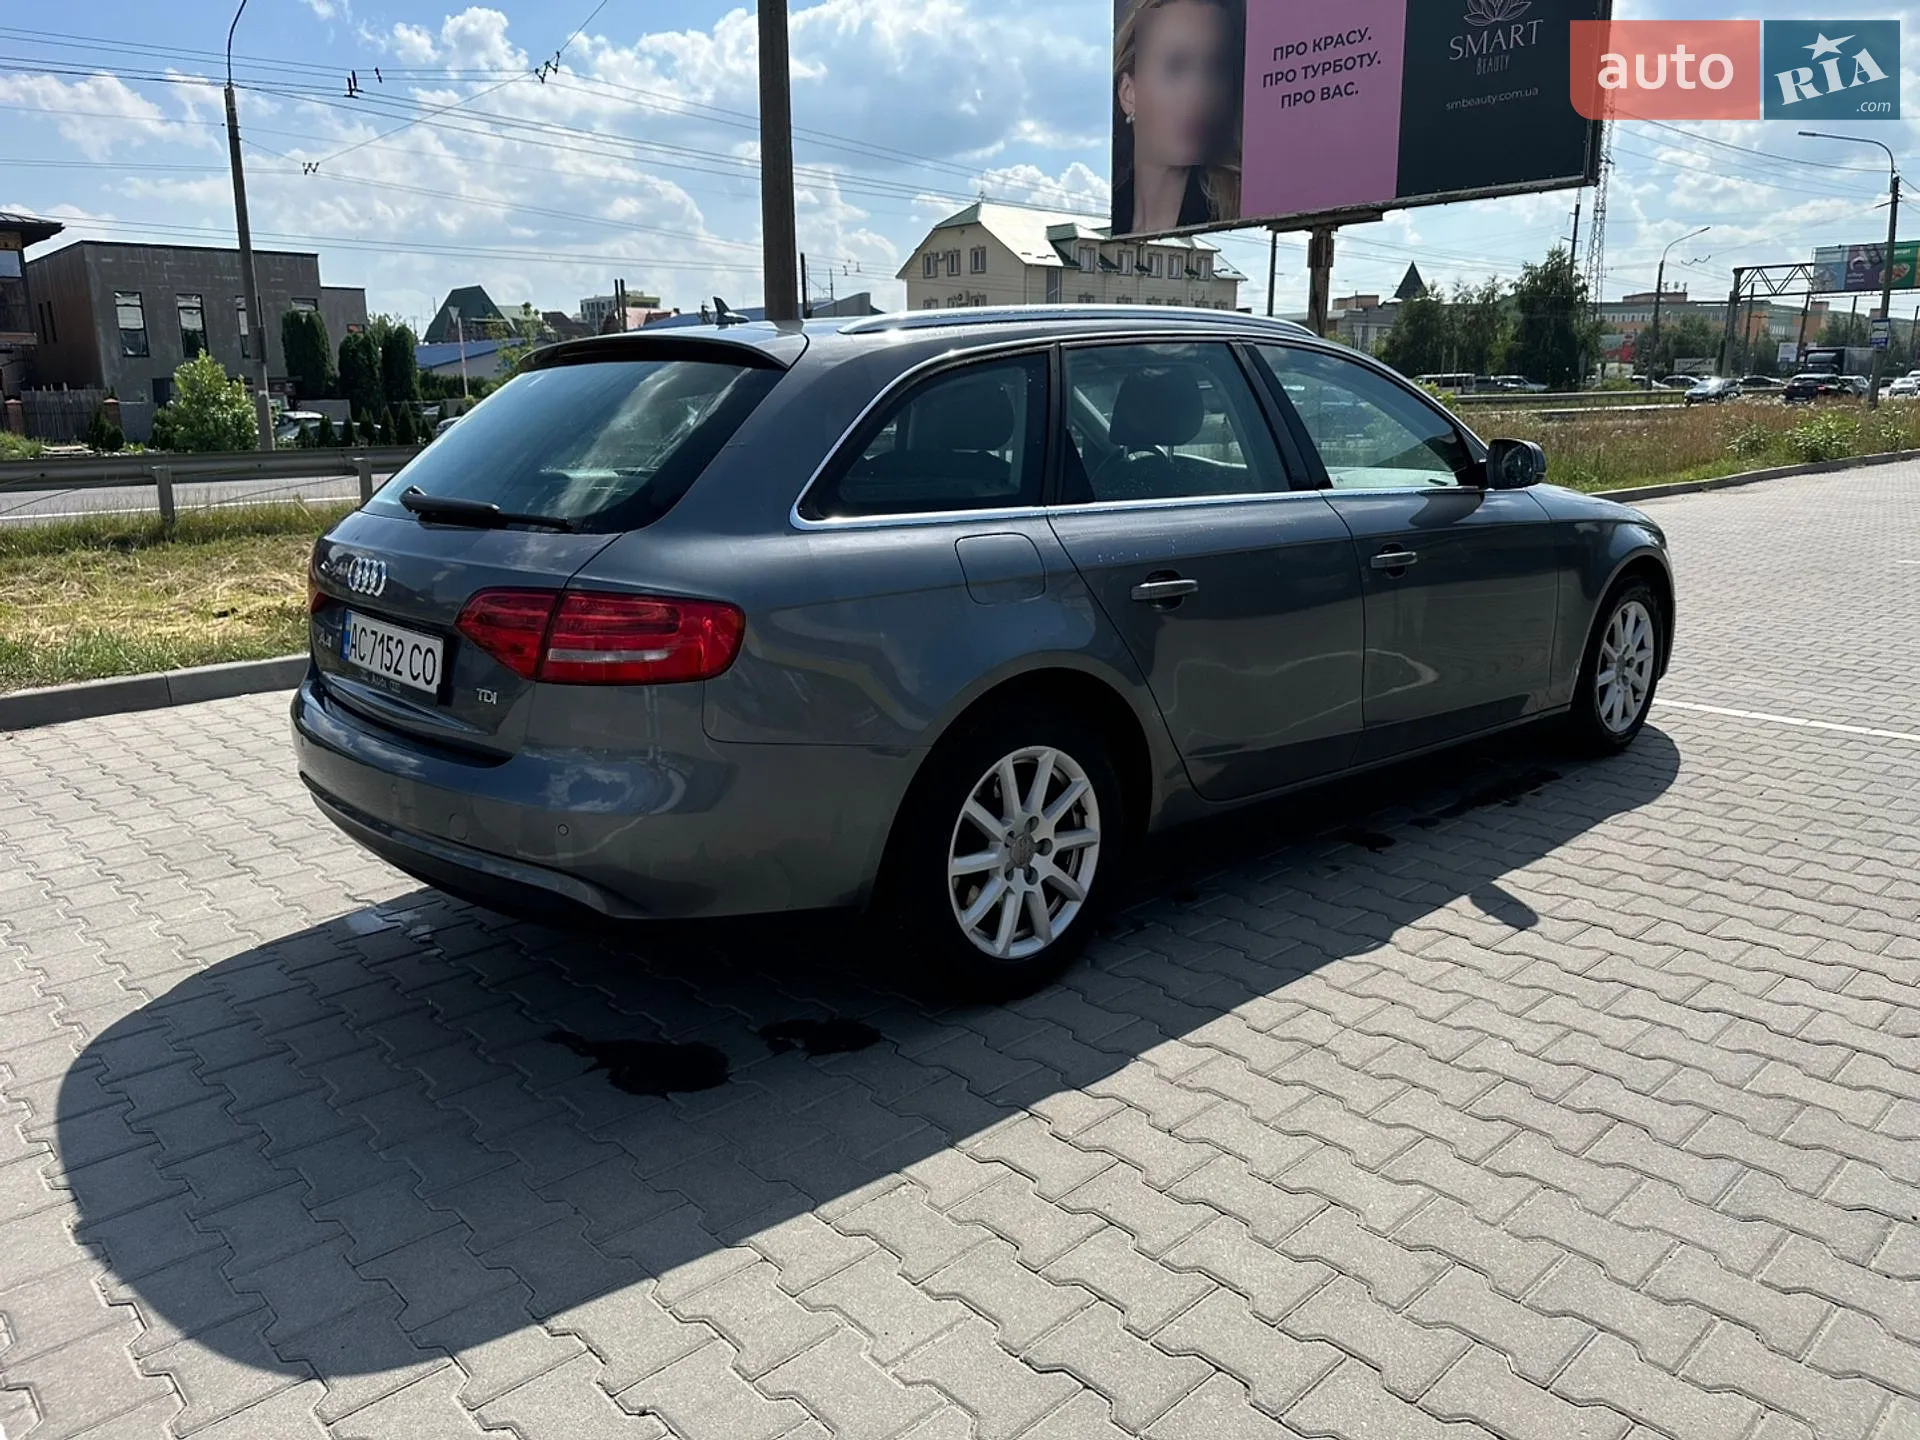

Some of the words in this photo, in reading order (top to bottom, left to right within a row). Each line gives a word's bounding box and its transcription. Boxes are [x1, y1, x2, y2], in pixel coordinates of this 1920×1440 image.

[1273, 41, 1308, 61] ПРО
[1312, 26, 1372, 53] КРАСУ.
[1448, 19, 1544, 61] SMART
[1262, 69, 1297, 88] ПРО
[1301, 51, 1381, 80] ТУРБОТУ.
[1476, 55, 1510, 76] BEAUTY
[1281, 90, 1316, 109] ПРО
[1320, 81, 1359, 101] ВАС.
[1446, 87, 1539, 111] smbeauty.com.ua
[409, 643, 437, 686] CO
[476, 687, 498, 705] TDI
